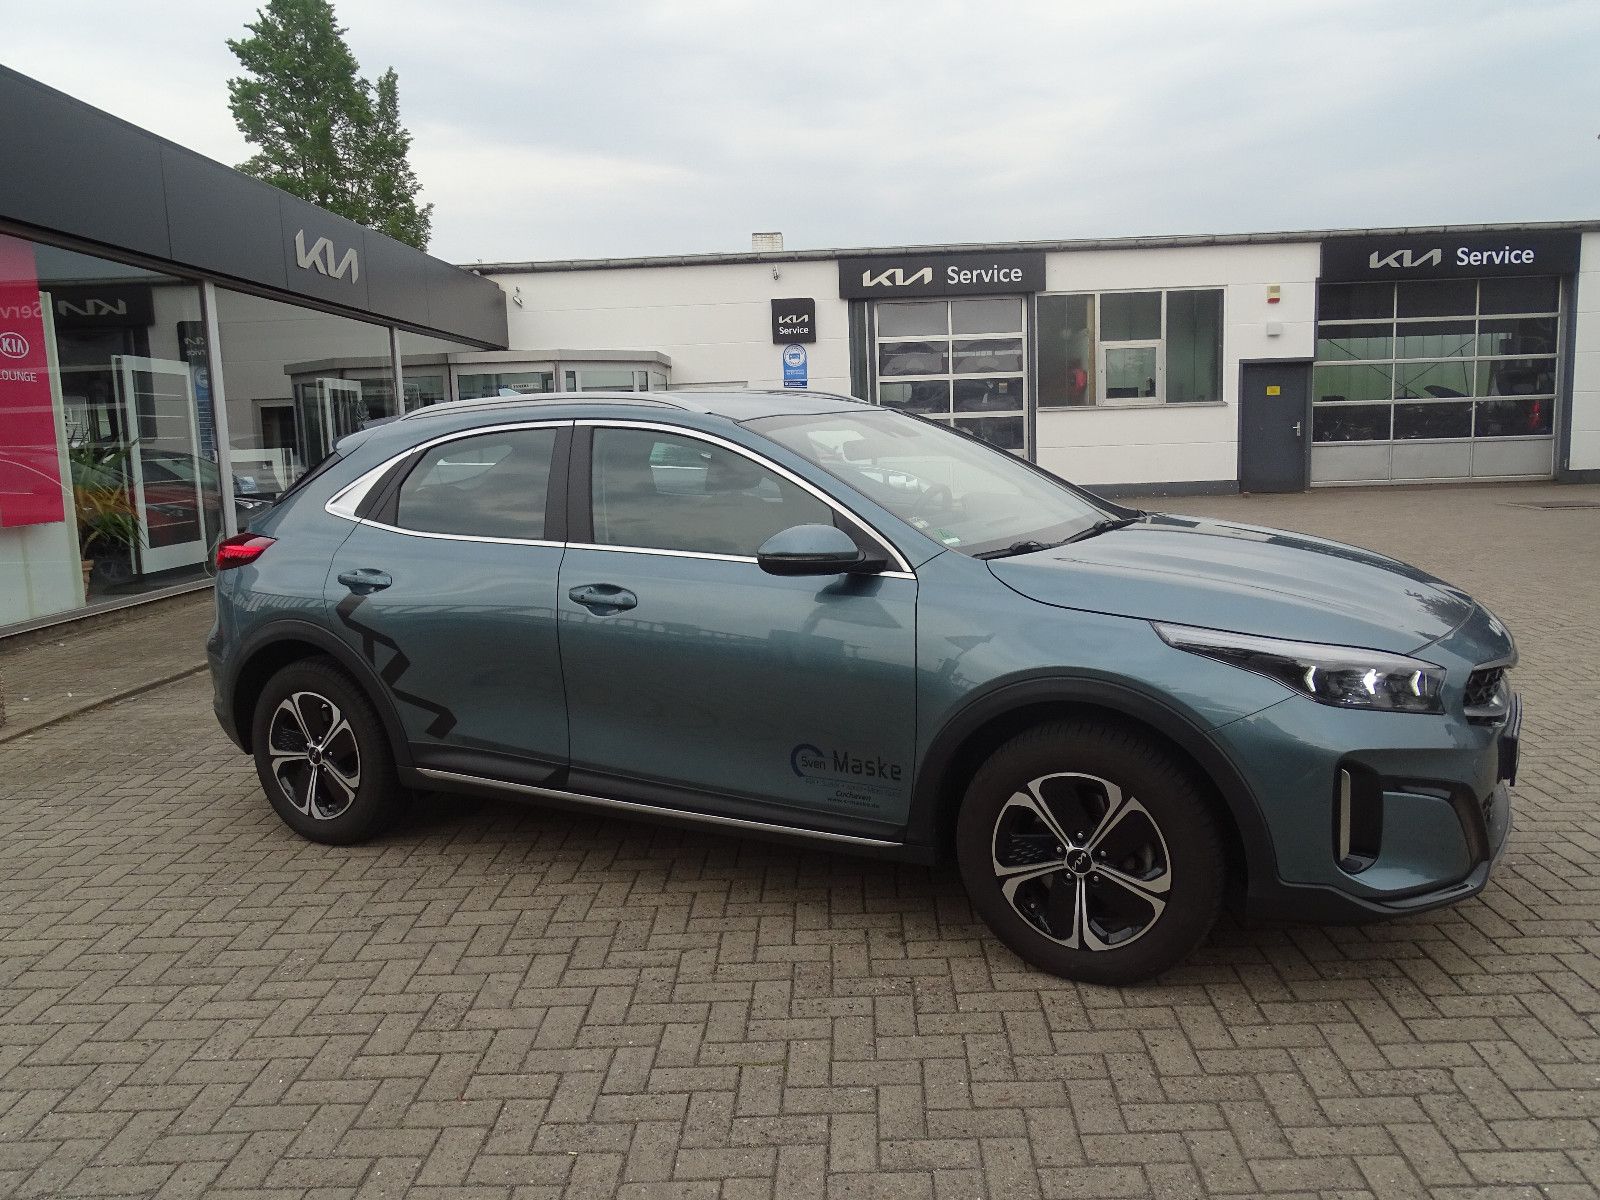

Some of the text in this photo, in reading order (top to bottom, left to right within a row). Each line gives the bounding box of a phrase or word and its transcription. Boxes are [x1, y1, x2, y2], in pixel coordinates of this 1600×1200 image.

[294, 229, 359, 285] KIA
[1368, 245, 1535, 269] KIA Service
[862, 264, 1023, 287] KIA Service
[778, 314, 809, 324] KIA
[778, 326, 809, 336] Service
[1, 337, 25, 354] KIA
[801, 750, 902, 781] Sven Maske
